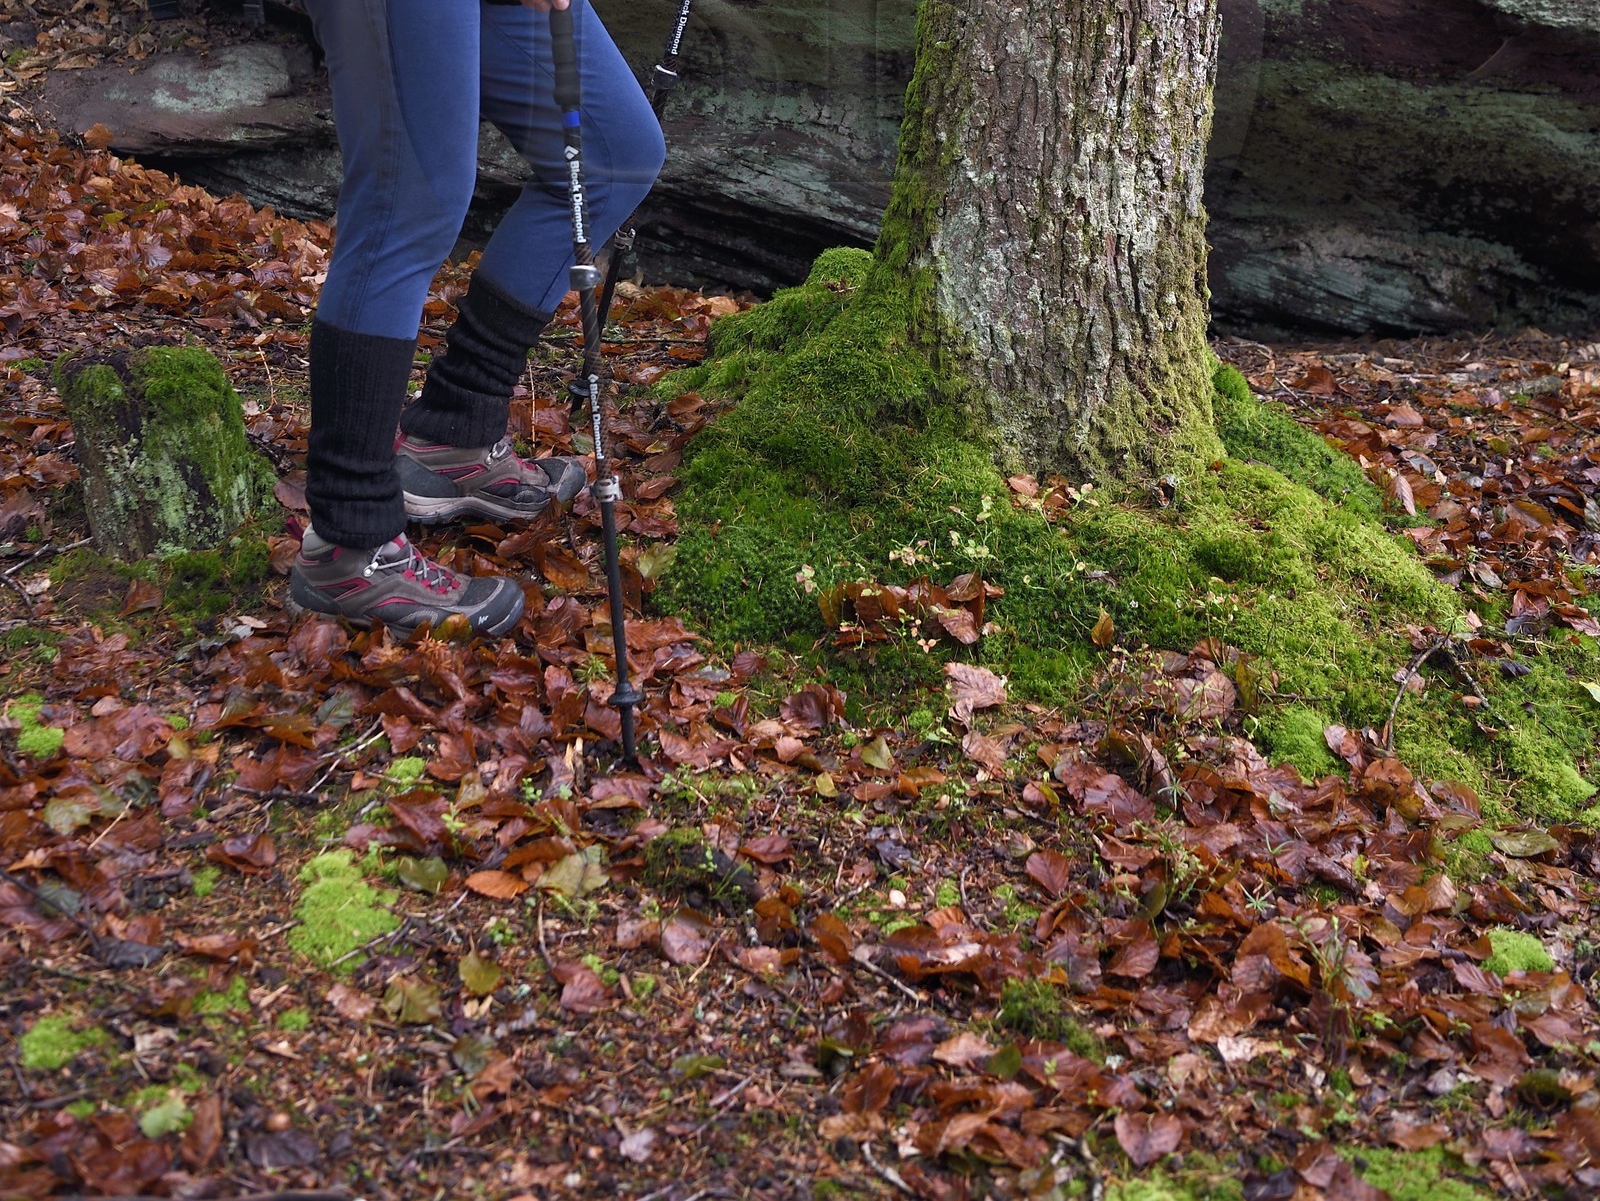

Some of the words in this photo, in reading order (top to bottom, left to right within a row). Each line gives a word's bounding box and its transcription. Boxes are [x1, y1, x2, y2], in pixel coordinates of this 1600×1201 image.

[670, 16, 688, 55] Diamond
[569, 160, 582, 192] Black
[573, 193, 587, 243] Diamond
[589, 383, 600, 412] Black
[592, 413, 605, 459] Diamond
